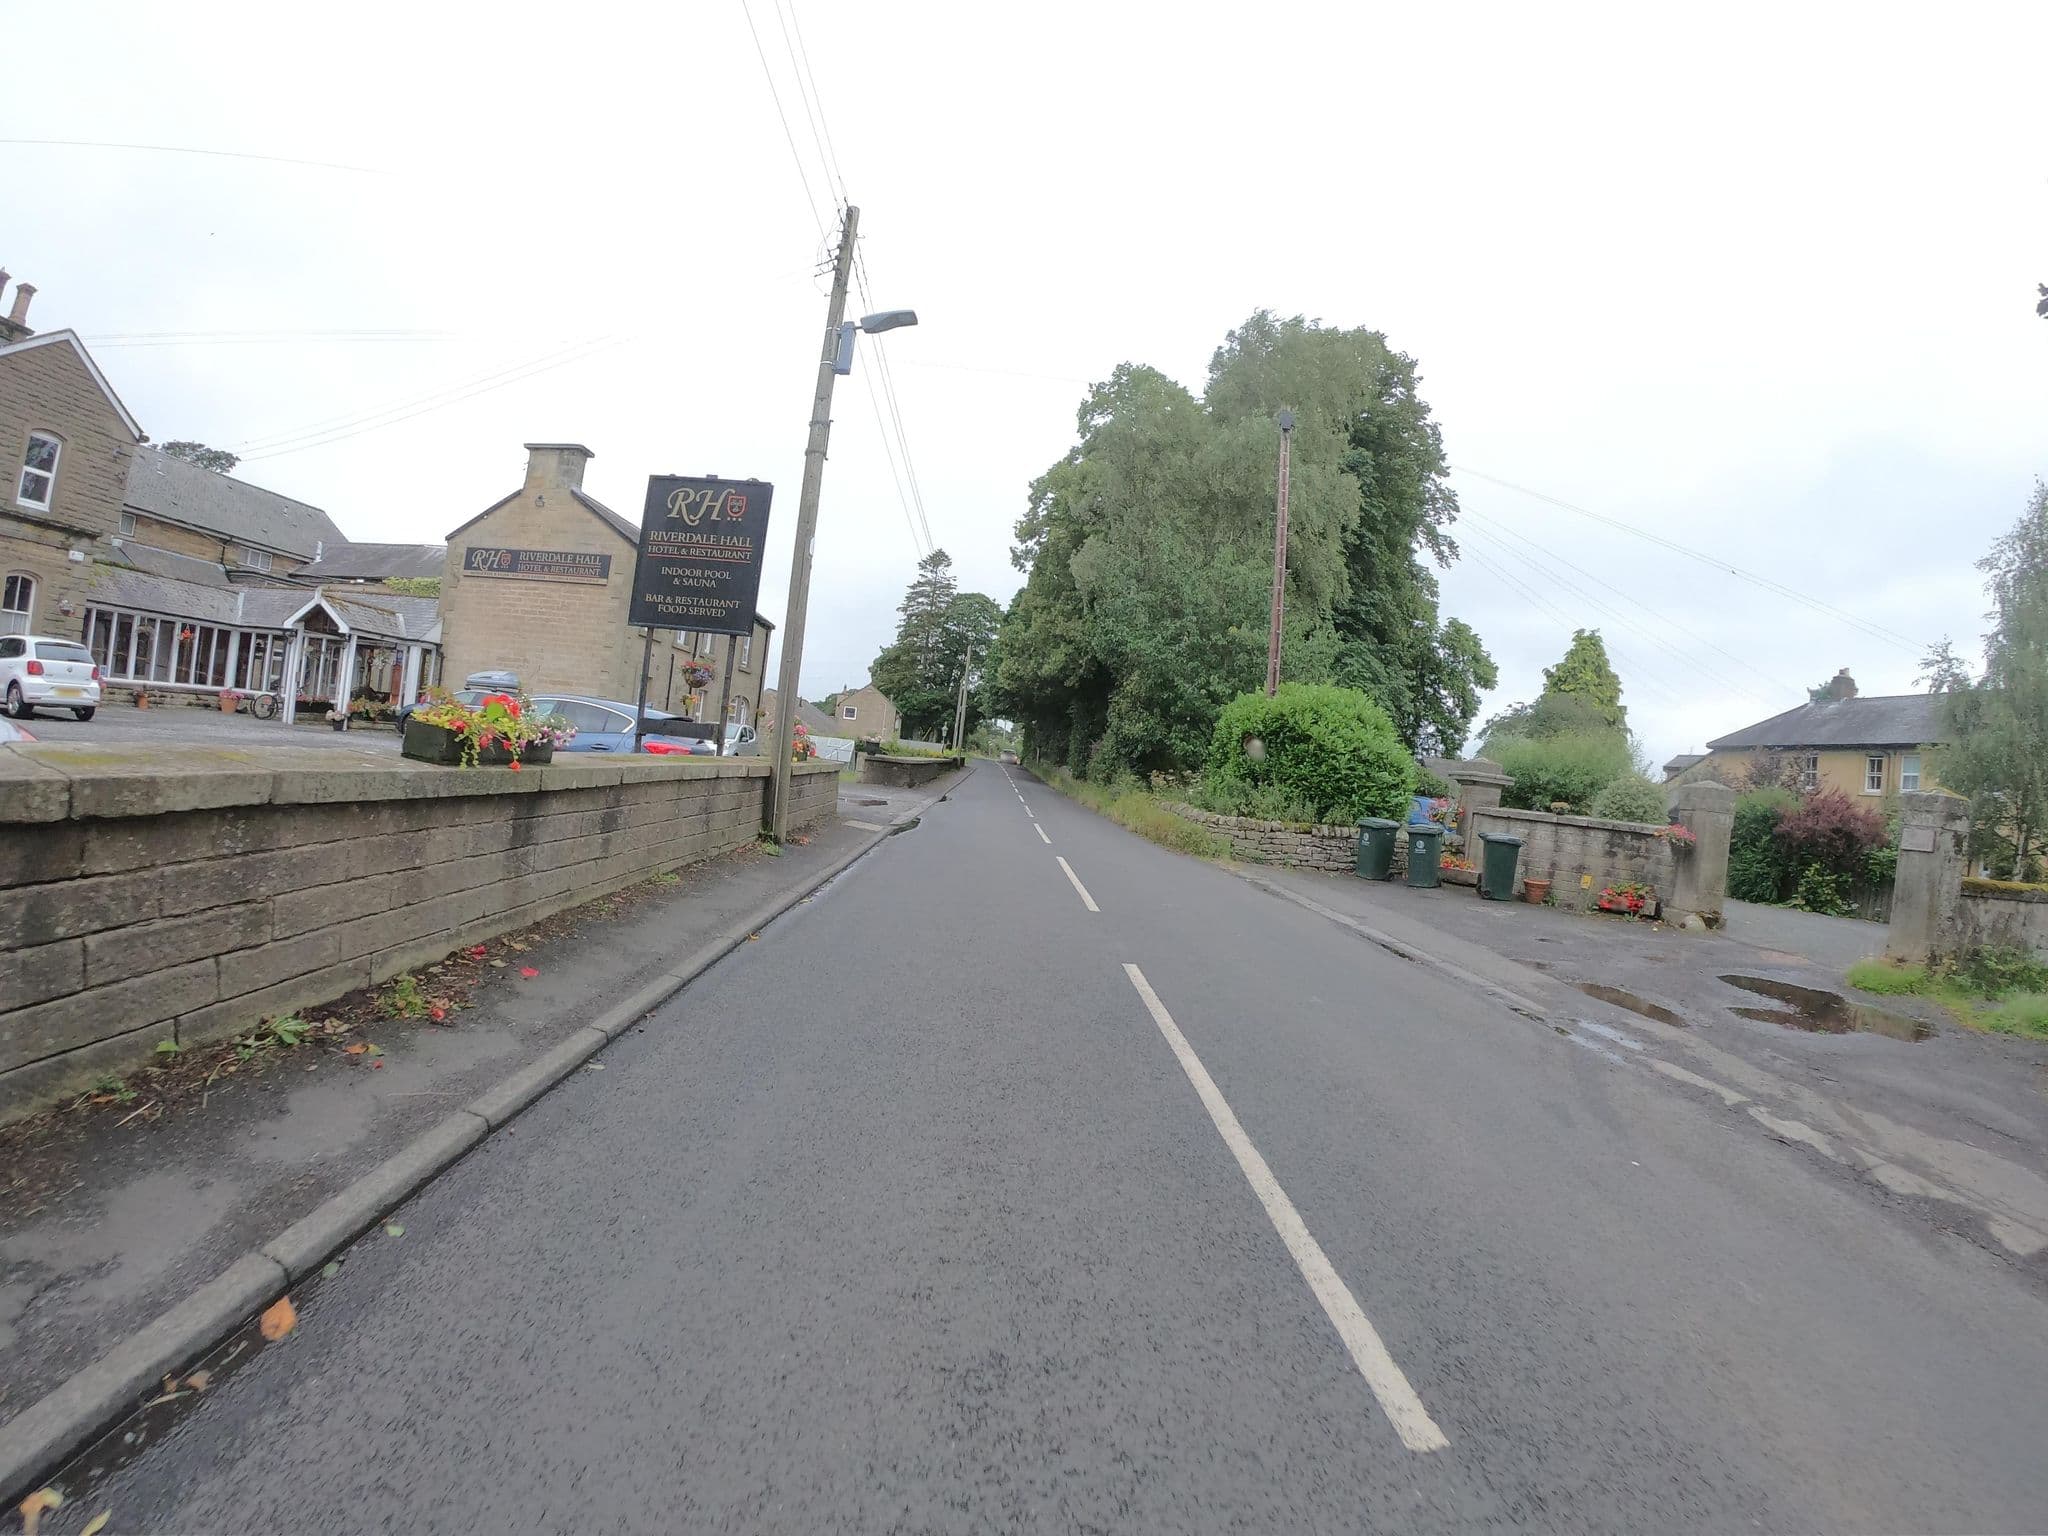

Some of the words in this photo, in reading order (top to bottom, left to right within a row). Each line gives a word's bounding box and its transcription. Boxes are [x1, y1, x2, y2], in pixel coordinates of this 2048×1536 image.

[667, 487, 736, 526] RH
[650, 530, 717, 544] RIVERDALE
[720, 536, 753, 547] HALL
[519, 552, 573, 563] RIVERDALE
[576, 555, 602, 565] HALL
[648, 546, 680, 555] HOTEL
[690, 549, 752, 560] RESTAURANT
[472, 549, 506, 571] RH
[518, 563, 541, 573] HOTEL
[552, 566, 601, 576] RESTAURANT
[661, 567, 703, 577] INDOOR
[704, 570, 731, 579] POOL
[682, 578, 716, 588] SAUNA
[646, 594, 664, 603] BAR
[675, 596, 741, 609] RESTAURANT
[658, 605, 687, 614] FOOD
[689, 607, 726, 617] SERVED
